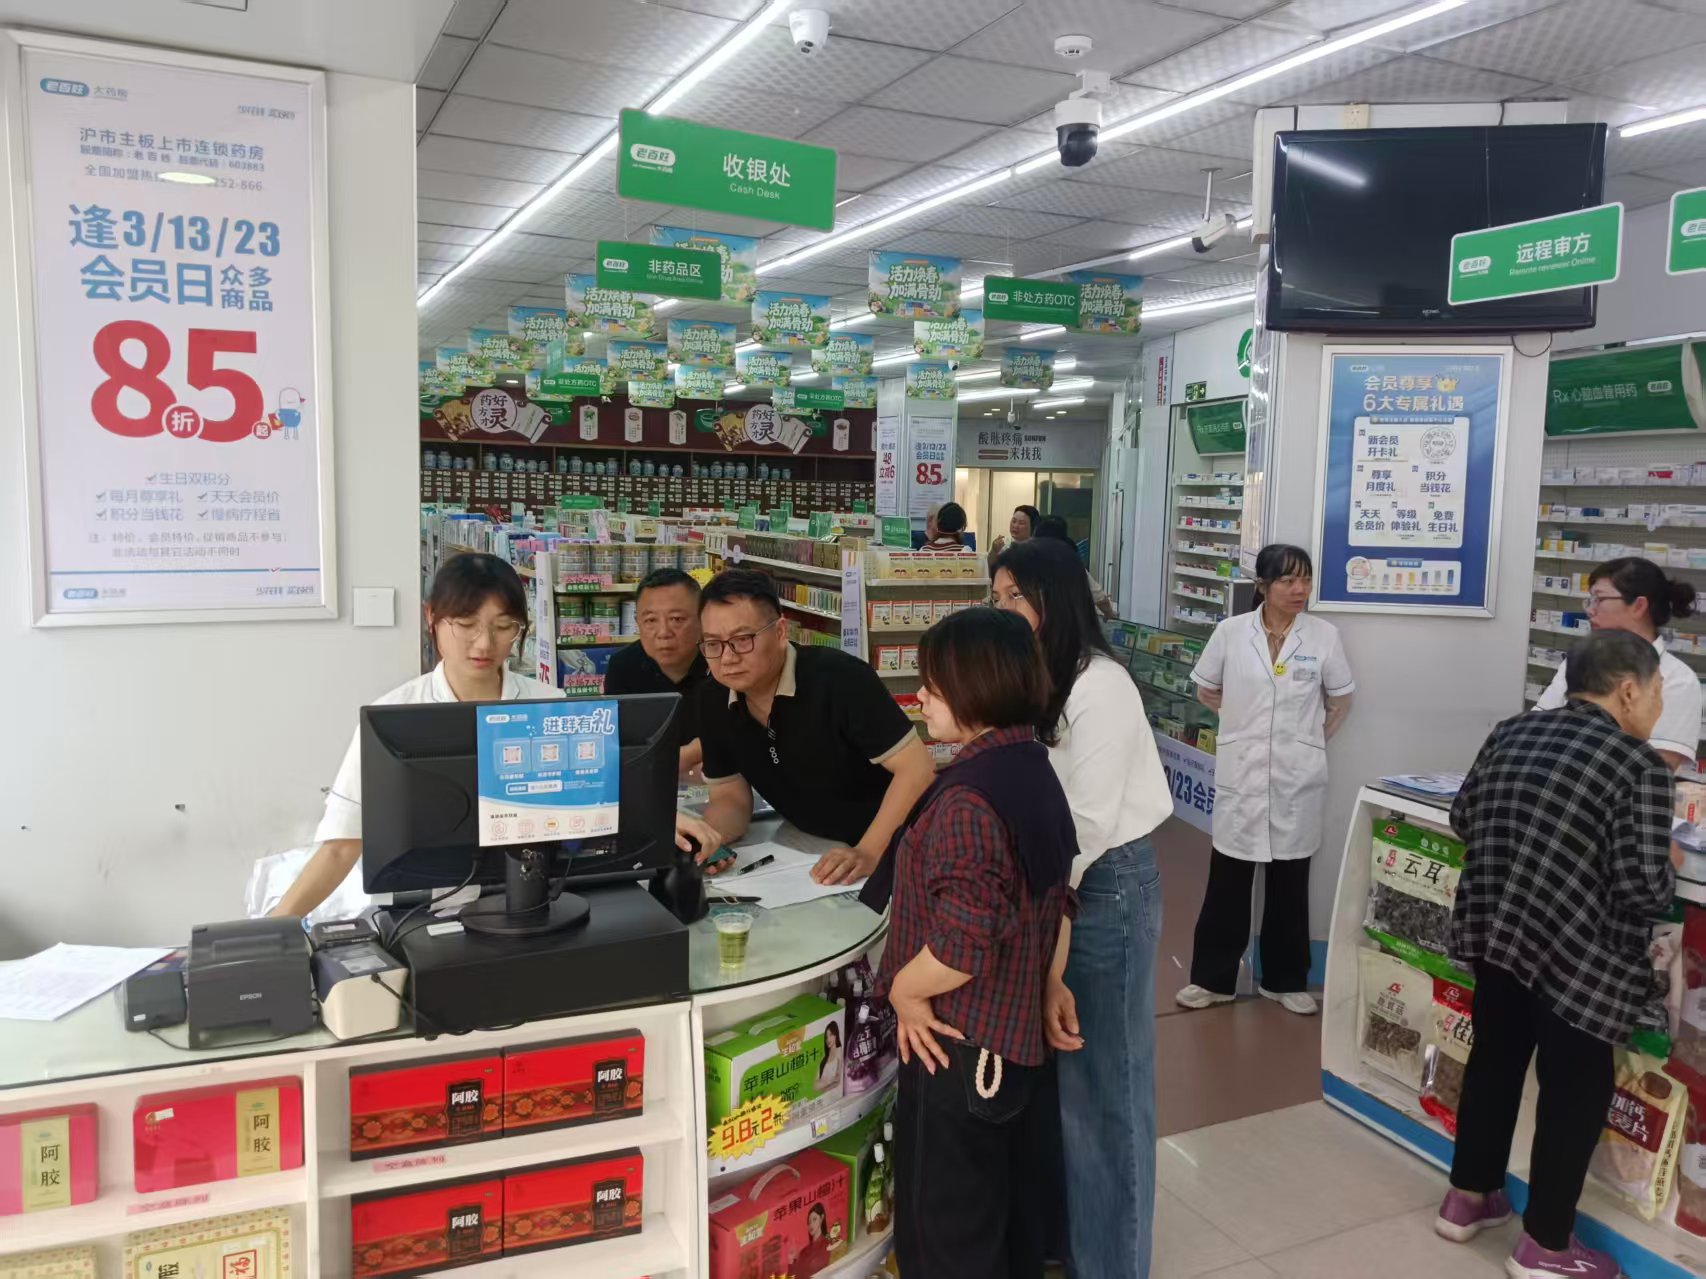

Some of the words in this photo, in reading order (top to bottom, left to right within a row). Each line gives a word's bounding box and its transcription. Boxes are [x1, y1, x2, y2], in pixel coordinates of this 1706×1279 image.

[80, 127, 264, 161] 沪市主板上市连锁药房
[723, 153, 791, 188] 收银处
[729, 183, 754, 196] Cash
[756, 186, 780, 200] Desk
[68, 204, 281, 257] 逢3/13/23
[1516, 232, 1592, 263] 远程审方
[648, 259, 702, 277] 非药品区
[890, 265, 940, 283] 活力焕春
[80, 254, 214, 308] 会员日
[219, 264, 273, 288] 众多
[890, 282, 942, 301] 加满骨劲
[1013, 290, 1075, 306] 非处方药OTC
[220, 288, 273, 312] 商品
[1080, 298, 1125, 317] 加满骨劲
[586, 301, 636, 318] 加满骨劲
[769, 302, 811, 318] 活力焕春
[768, 315, 813, 332] 加满骨劲
[1365, 375, 1432, 391] 会员尊享
[1363, 393, 1464, 412] 6大专属礼遇
[171, 411, 194, 432] 折
[979, 432, 1022, 446] 酸胀疼痛
[1368, 435, 1399, 445] 新会员
[1011, 447, 1042, 460] 来找我
[1368, 447, 1398, 457] 开卡礼
[160, 473, 231, 485] 生日双积分
[1371, 470, 1392, 480] 尊享
[1426, 471, 1446, 481] 积分
[1366, 482, 1396, 492] 月度礼
[1420, 483, 1451, 493] 当钱花
[211, 490, 280, 504] 天天会员价
[110, 508, 183, 521] 积分当钱花
[1360, 509, 1381, 519] 天天
[1397, 509, 1416, 519] 等级
[1433, 511, 1454, 521] 免费
[1354, 520, 1385, 531] 会员价
[1391, 520, 1421, 531] 体验礼
[1427, 522, 1458, 533] 生日礼
[544, 708, 615, 735] 进群有礼
[1404, 853, 1445, 884] 云耳
[597, 1068, 623, 1082] 阿胶
[744, 1047, 819, 1092] 苹果山楂汁
[452, 1090, 479, 1105] 阿胶
[253, 1113, 272, 1153] 阿胶
[41, 1143, 62, 1188] 阿胶
[597, 1187, 622, 1202] 阿胶
[452, 1212, 479, 1228] 阿胶
